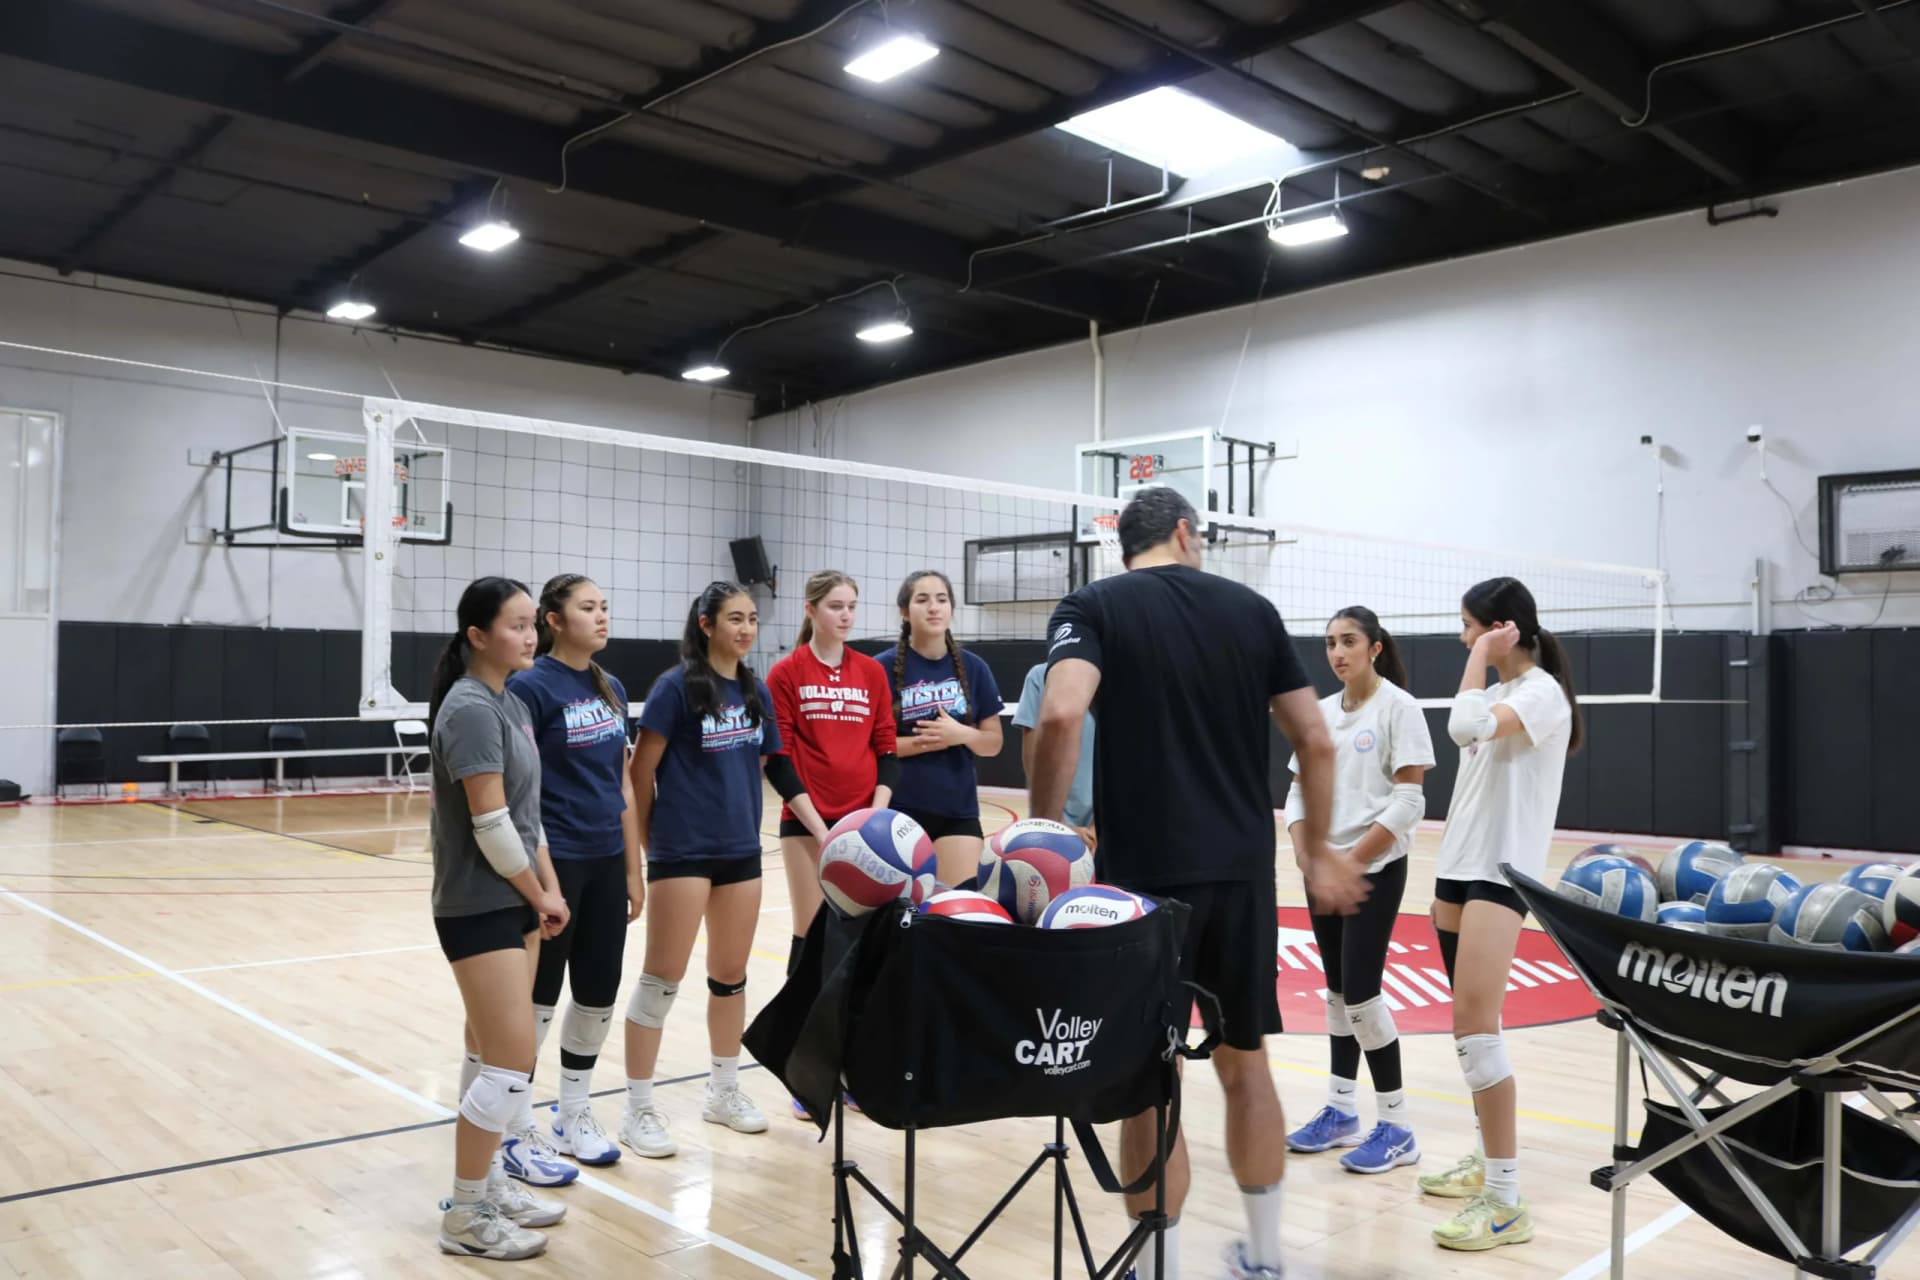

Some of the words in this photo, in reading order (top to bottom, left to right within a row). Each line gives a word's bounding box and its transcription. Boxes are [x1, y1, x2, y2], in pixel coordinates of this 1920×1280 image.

[1130, 454, 1153, 480] 22
[799, 685, 870, 704] VOLLEYBALL
[1065, 904, 1119, 921] molten
[1617, 941, 1788, 1018] molten
[1036, 1007, 1103, 1041] Volley
[1015, 1039, 1090, 1066] CART
